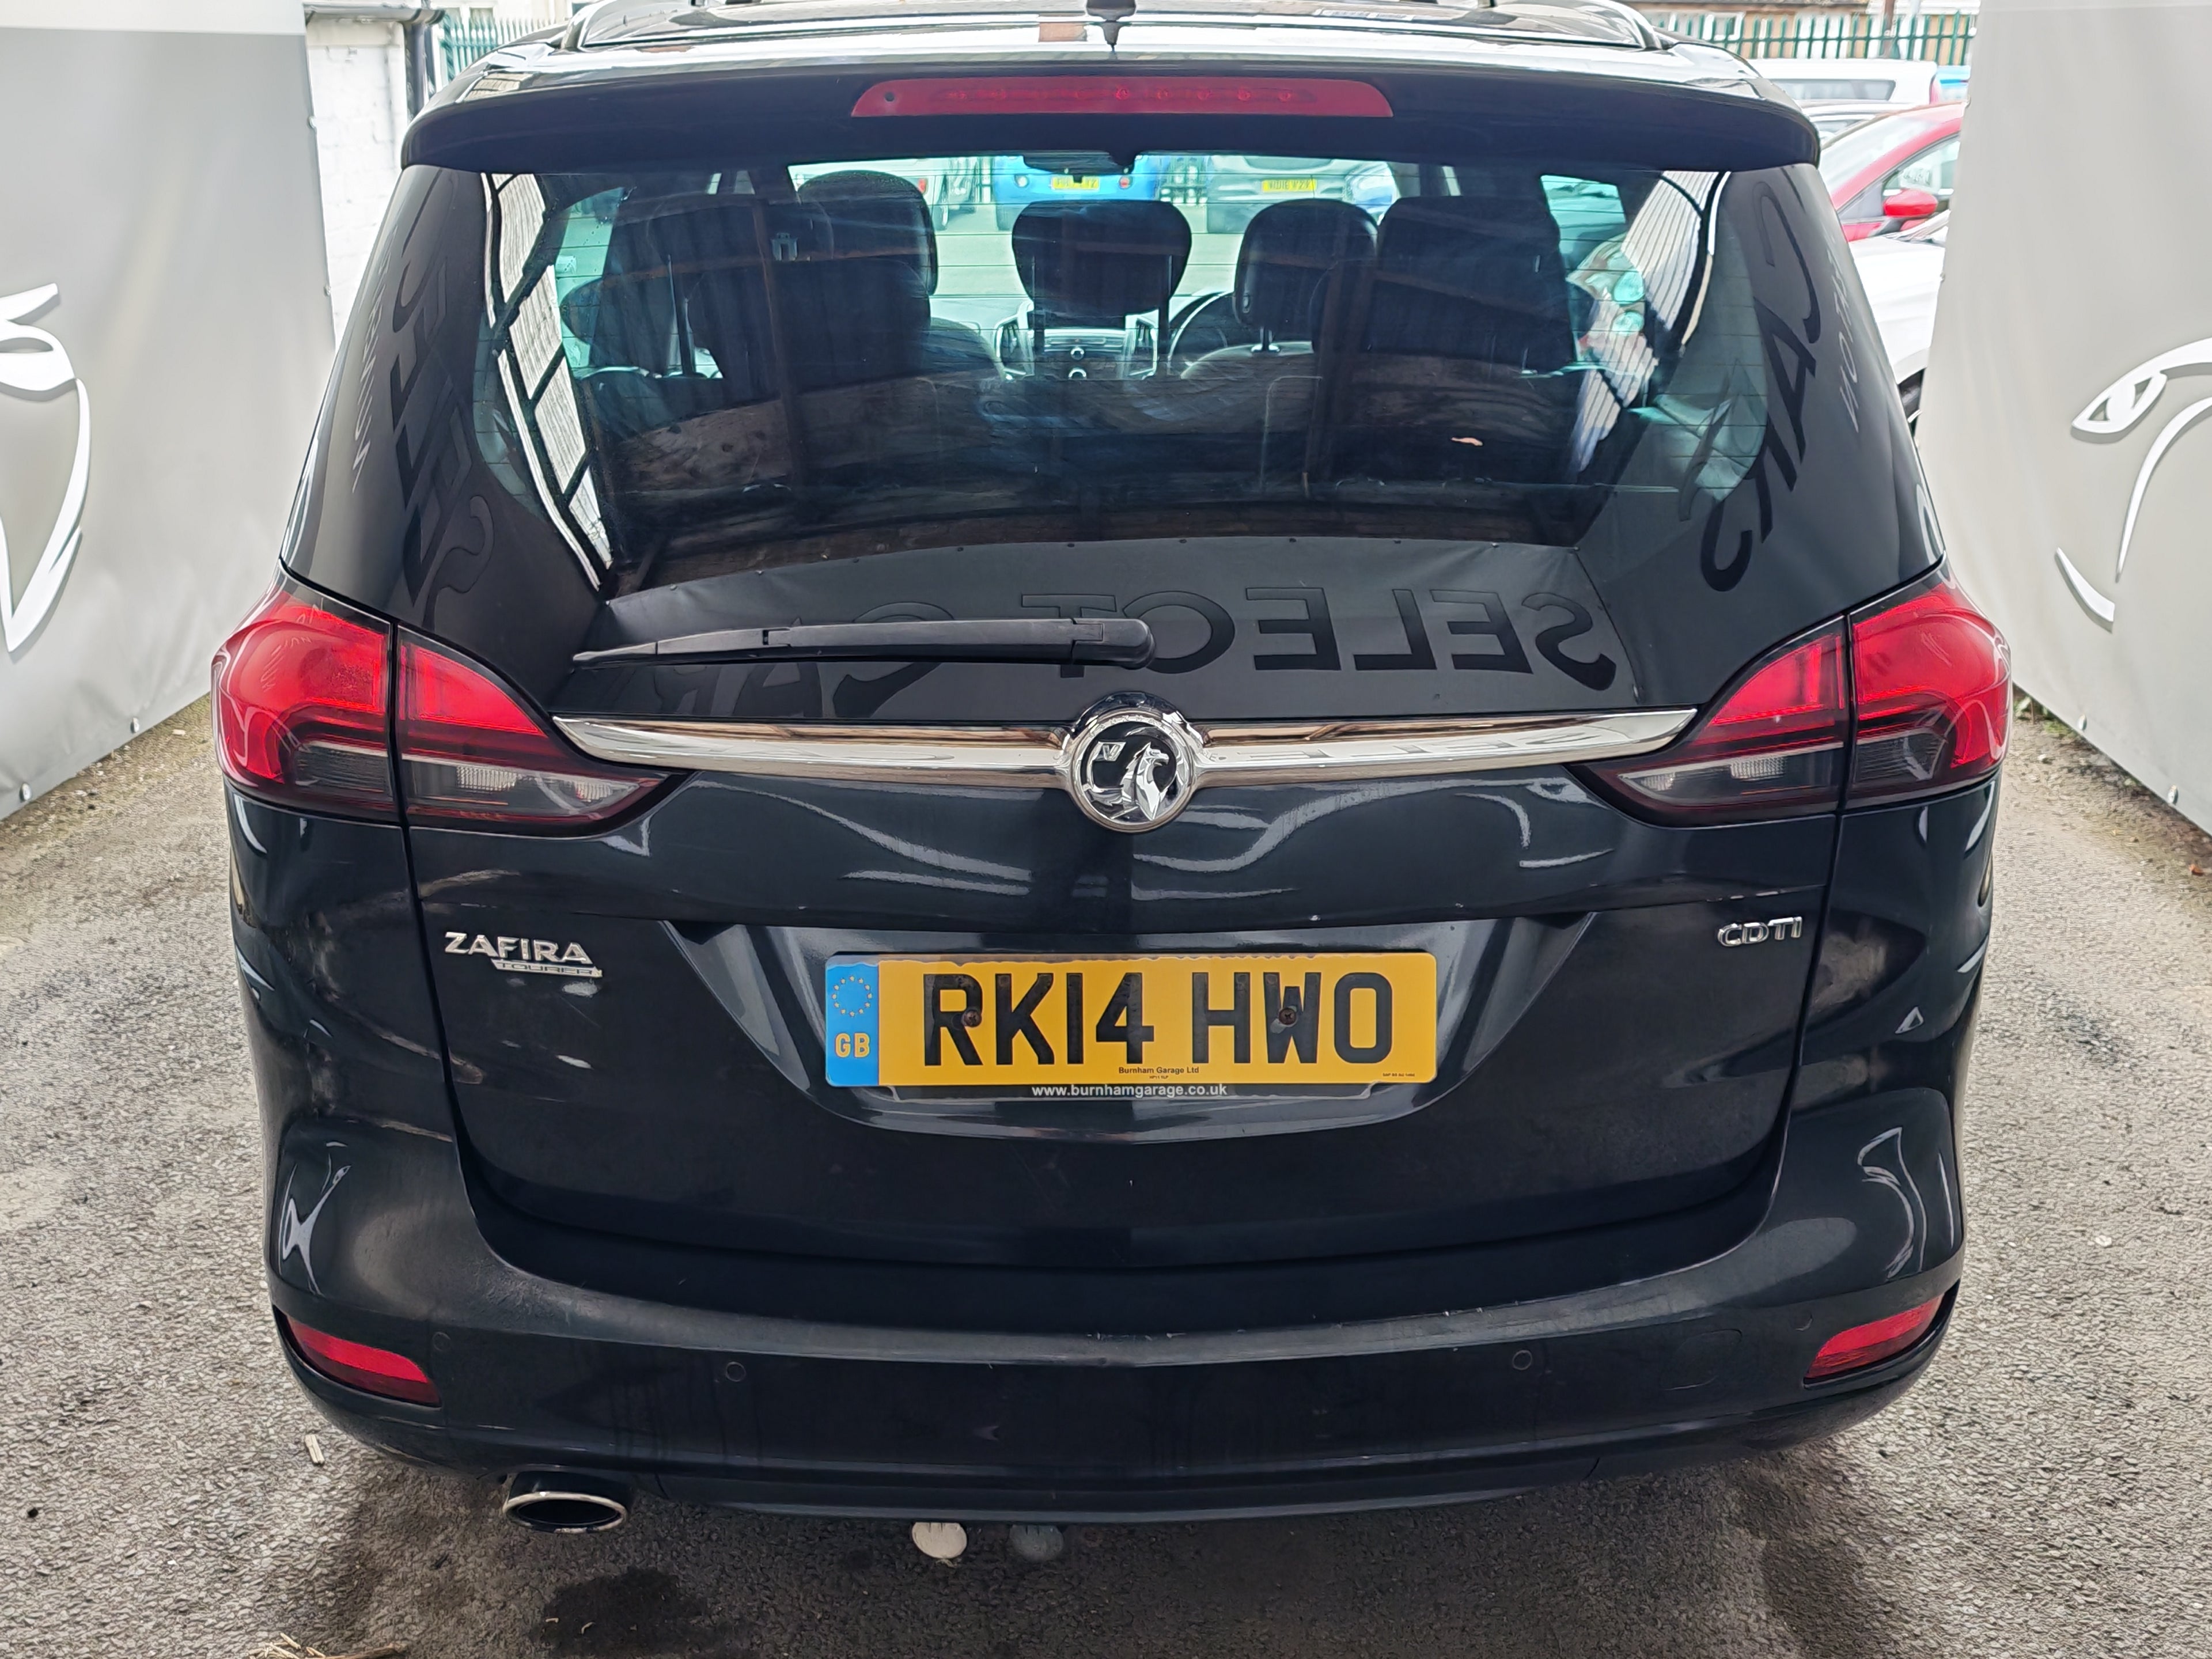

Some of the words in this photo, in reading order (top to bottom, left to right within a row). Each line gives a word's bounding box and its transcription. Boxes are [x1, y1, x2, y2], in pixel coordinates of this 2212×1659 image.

[1717, 916, 1802, 946] CDTI
[445, 931, 593, 964] ZAFIRA
[499, 960, 593, 975] TOURER
[923, 972, 1154, 1066] RK14
[1192, 972, 1392, 1065] HWO
[835, 1033, 870, 1058] GB
[1156, 1066, 1184, 1075] Garage
[1032, 1084, 1228, 1098] www.burnhamgarage.co.uk
